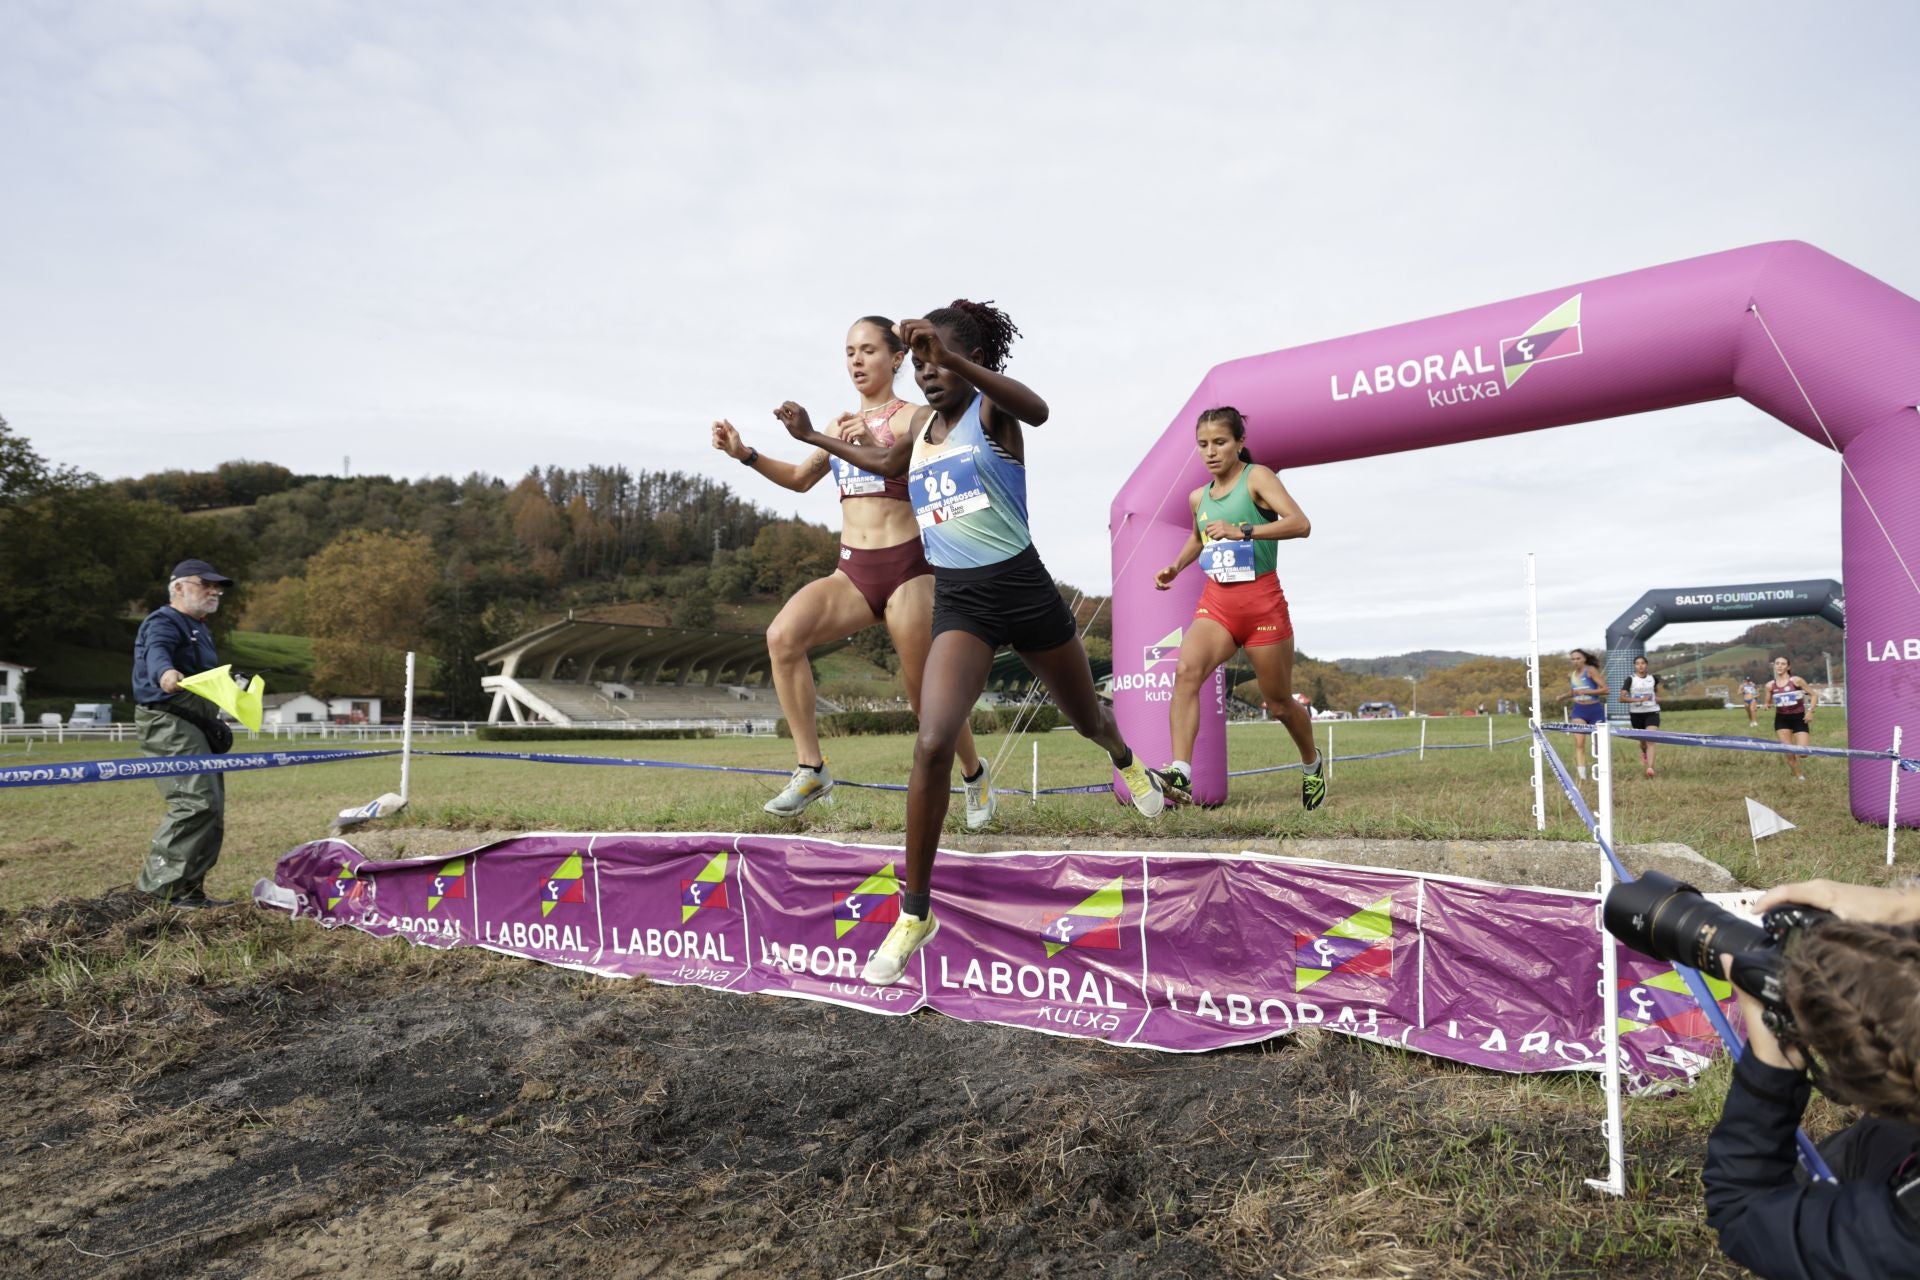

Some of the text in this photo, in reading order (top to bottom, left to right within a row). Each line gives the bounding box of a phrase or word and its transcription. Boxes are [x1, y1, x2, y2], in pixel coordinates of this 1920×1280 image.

[1331, 345, 1496, 401] LABORAL
[1427, 379, 1501, 408] kutxa
[924, 471, 957, 502] 26
[1212, 549, 1236, 569] 28
[1675, 594, 1713, 605] SALTO
[1715, 589, 1794, 603] FOUNDATION
[1866, 638, 1920, 662] LAB
[119, 760, 200, 777] GIPUZKOA
[486, 920, 589, 952] LABORAL
[612, 927, 735, 962] LABORAL
[759, 935, 877, 979] LABOR
[940, 955, 1128, 1010] LABORAL
[1037, 1005, 1121, 1031] kutxa
